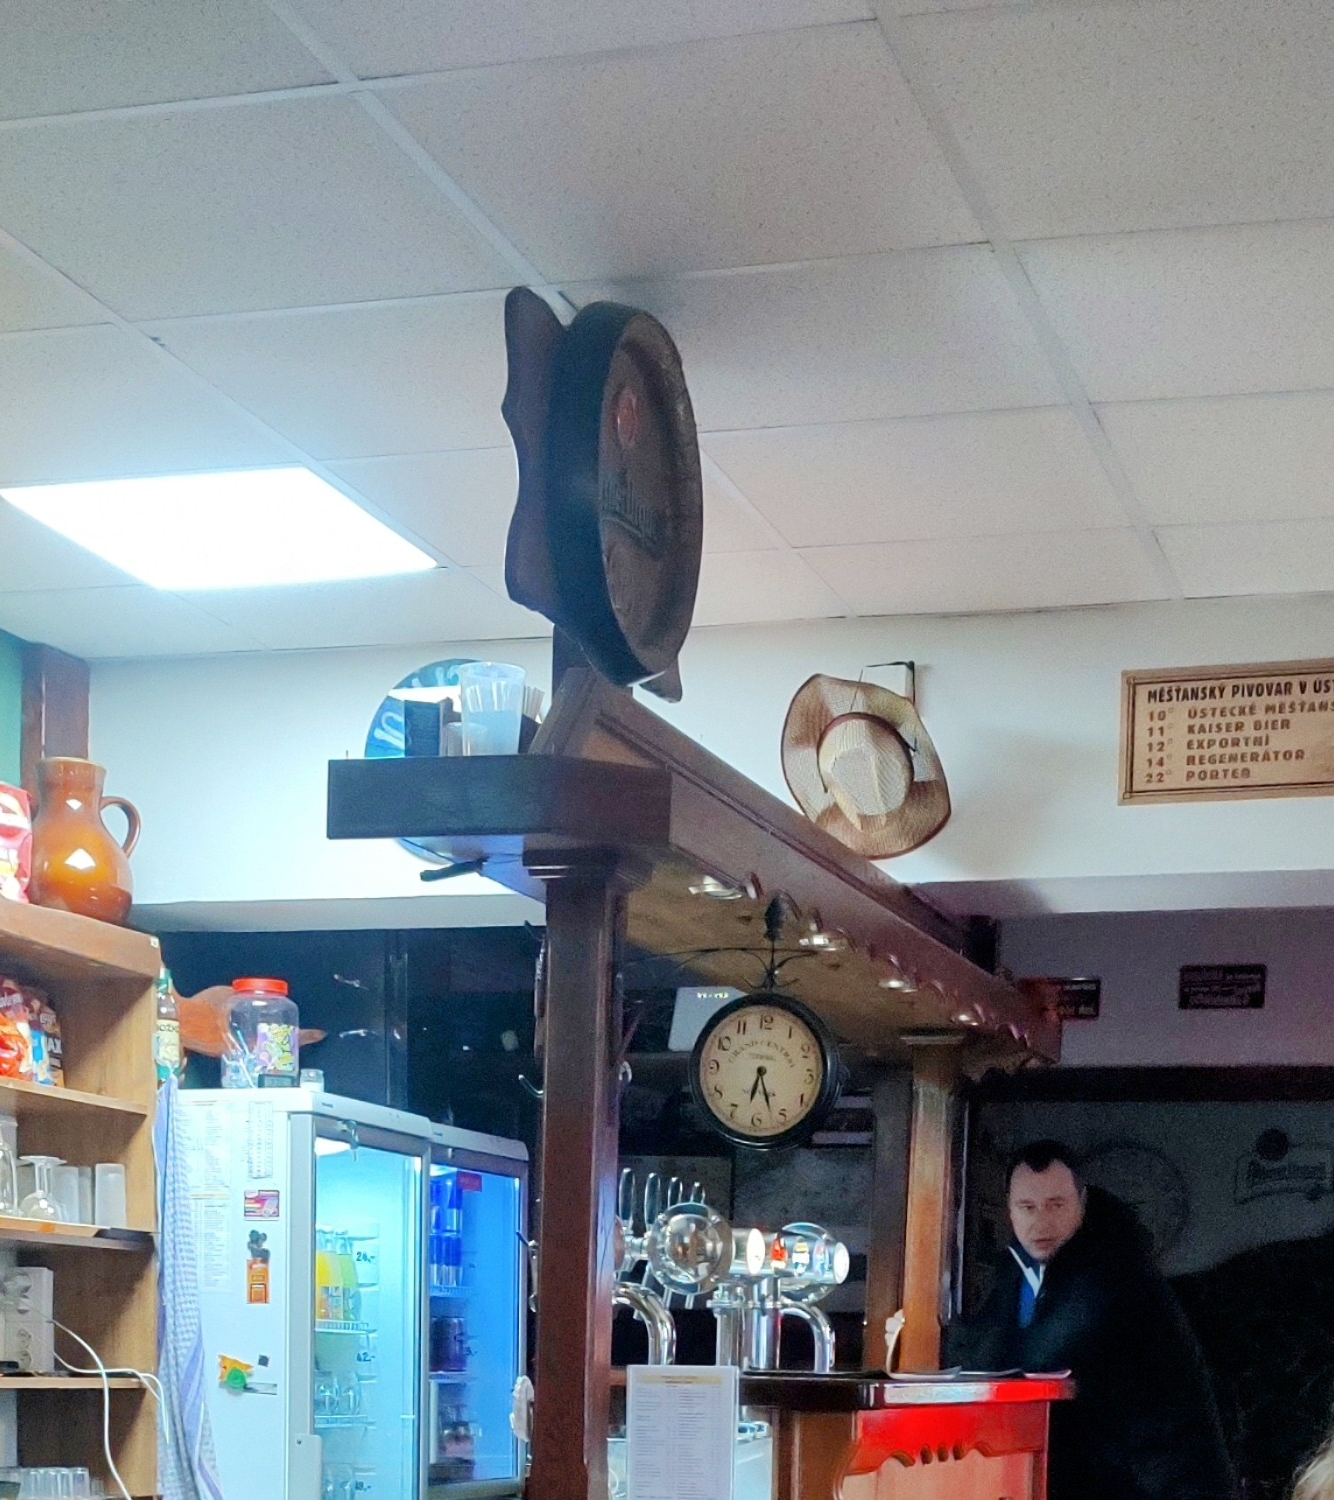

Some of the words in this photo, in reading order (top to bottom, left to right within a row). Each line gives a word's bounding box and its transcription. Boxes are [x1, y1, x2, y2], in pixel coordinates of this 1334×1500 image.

[1230, 680, 1293, 698] PIVOVAR
[1299, 680, 1308, 695] V
[1186, 721, 1245, 735] KAISER
[1253, 718, 1291, 731] BIER
[1185, 767, 1251, 782] PORTER
[736, 1019, 747, 1036] 11
[759, 1014, 774, 1031] 12
[717, 1036, 732, 1052] 10
[750, 1111, 763, 1128] 6
